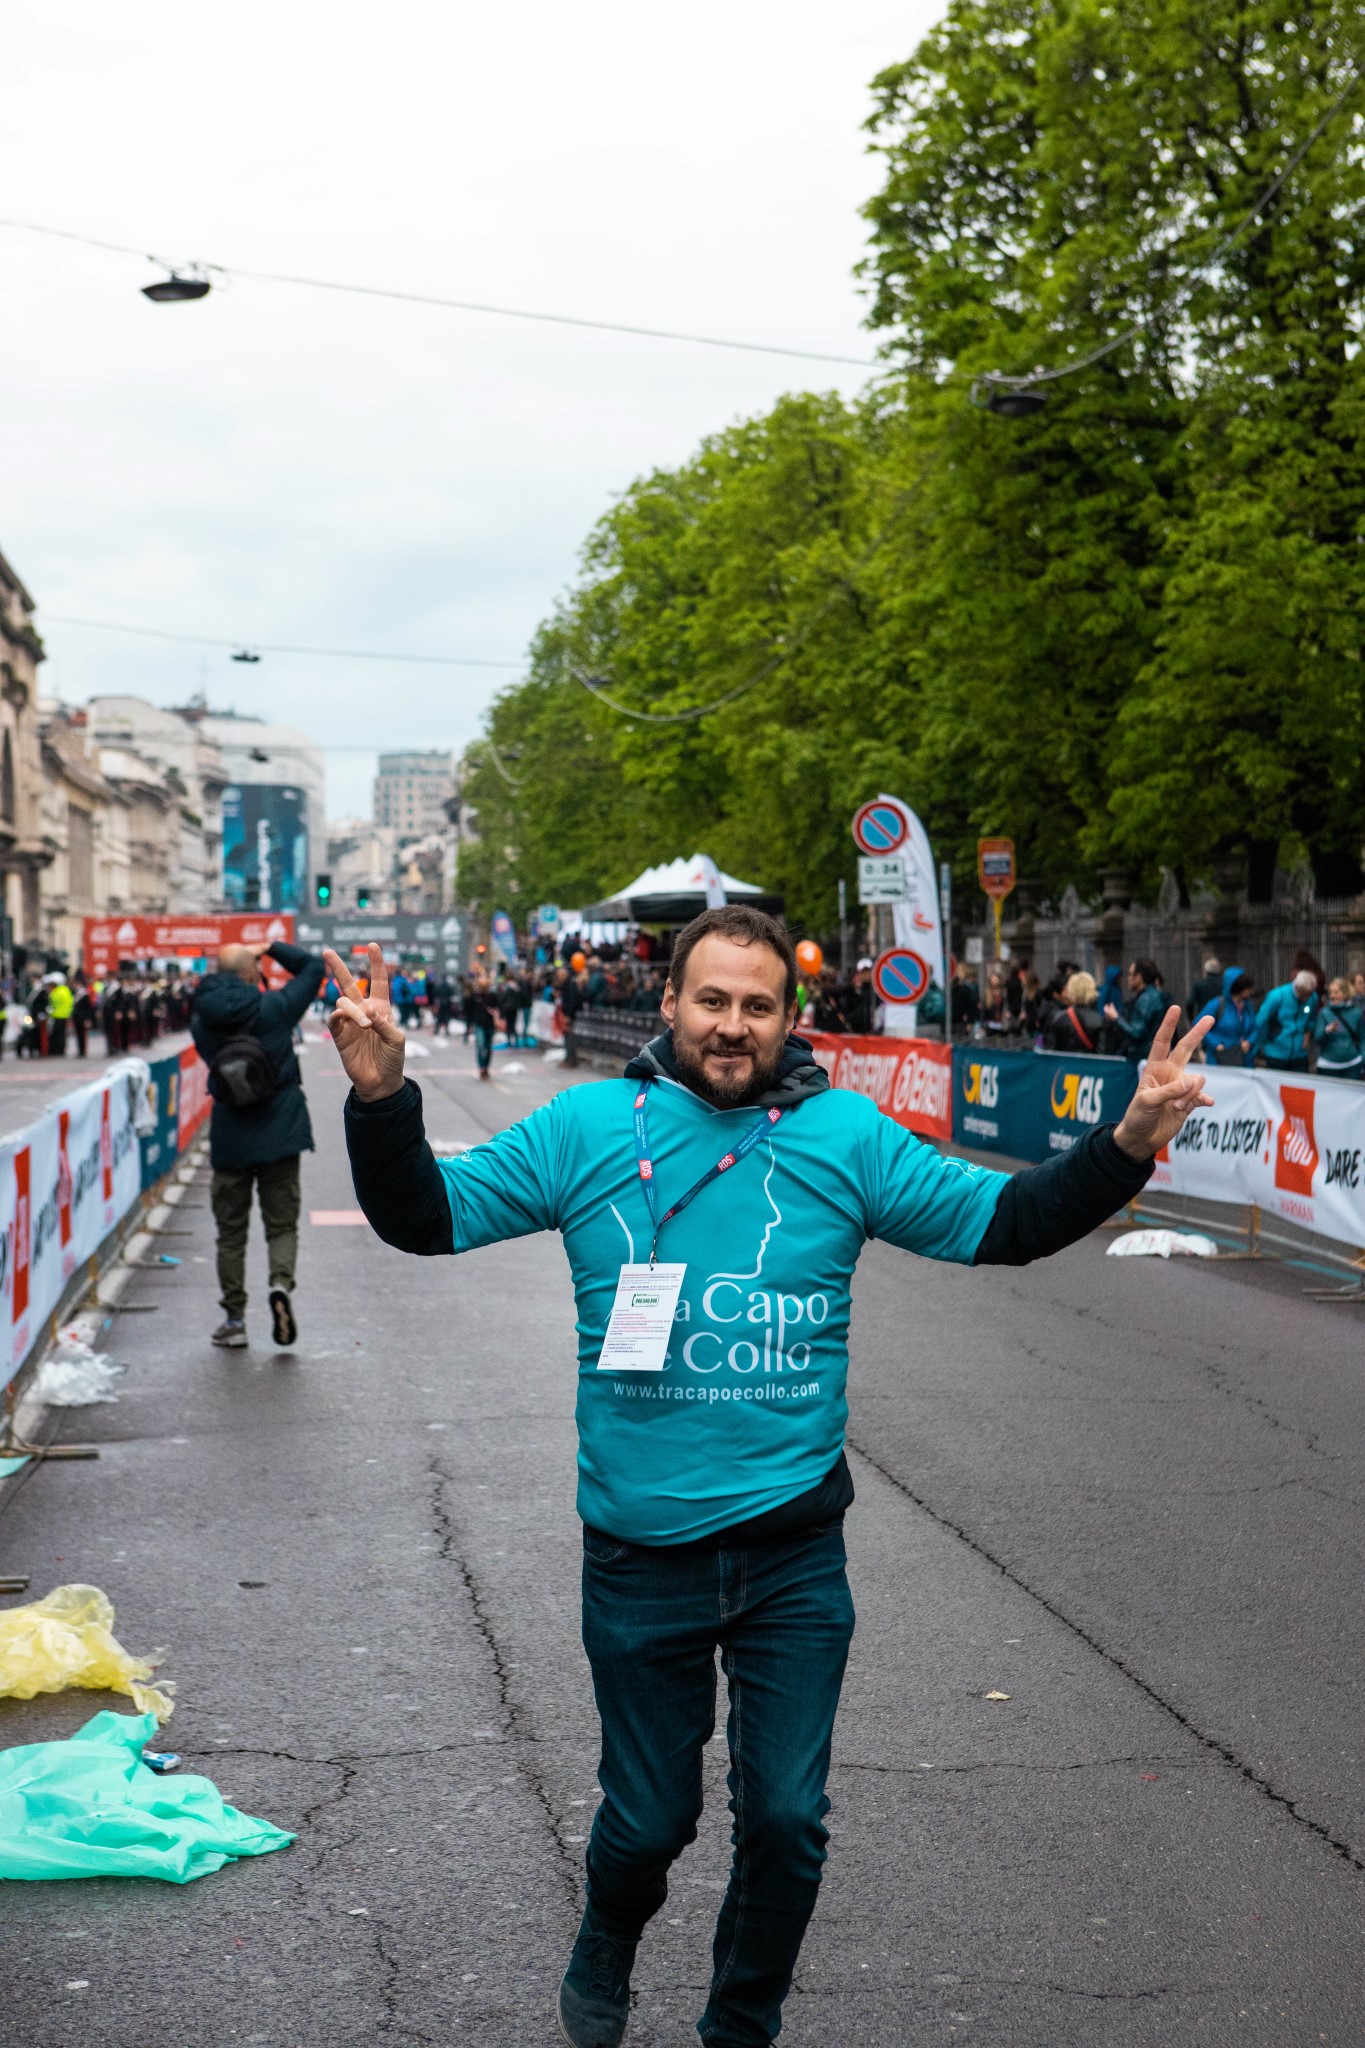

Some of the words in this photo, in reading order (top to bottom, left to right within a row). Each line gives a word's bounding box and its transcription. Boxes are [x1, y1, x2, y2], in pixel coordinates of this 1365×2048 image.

[980, 1064, 999, 1108] GLS
[1076, 1074, 1104, 1125] GLS
[1205, 1121, 1219, 1150] TO
[640, 1160, 653, 1178] RDS
[717, 1154, 734, 1171] RDS
[1325, 1148, 1361, 1190] DARE
[702, 1281, 829, 1340] Capo
[682, 1327, 812, 1374] Collo
[613, 1380, 820, 1405] www.tracapoecollo.com
